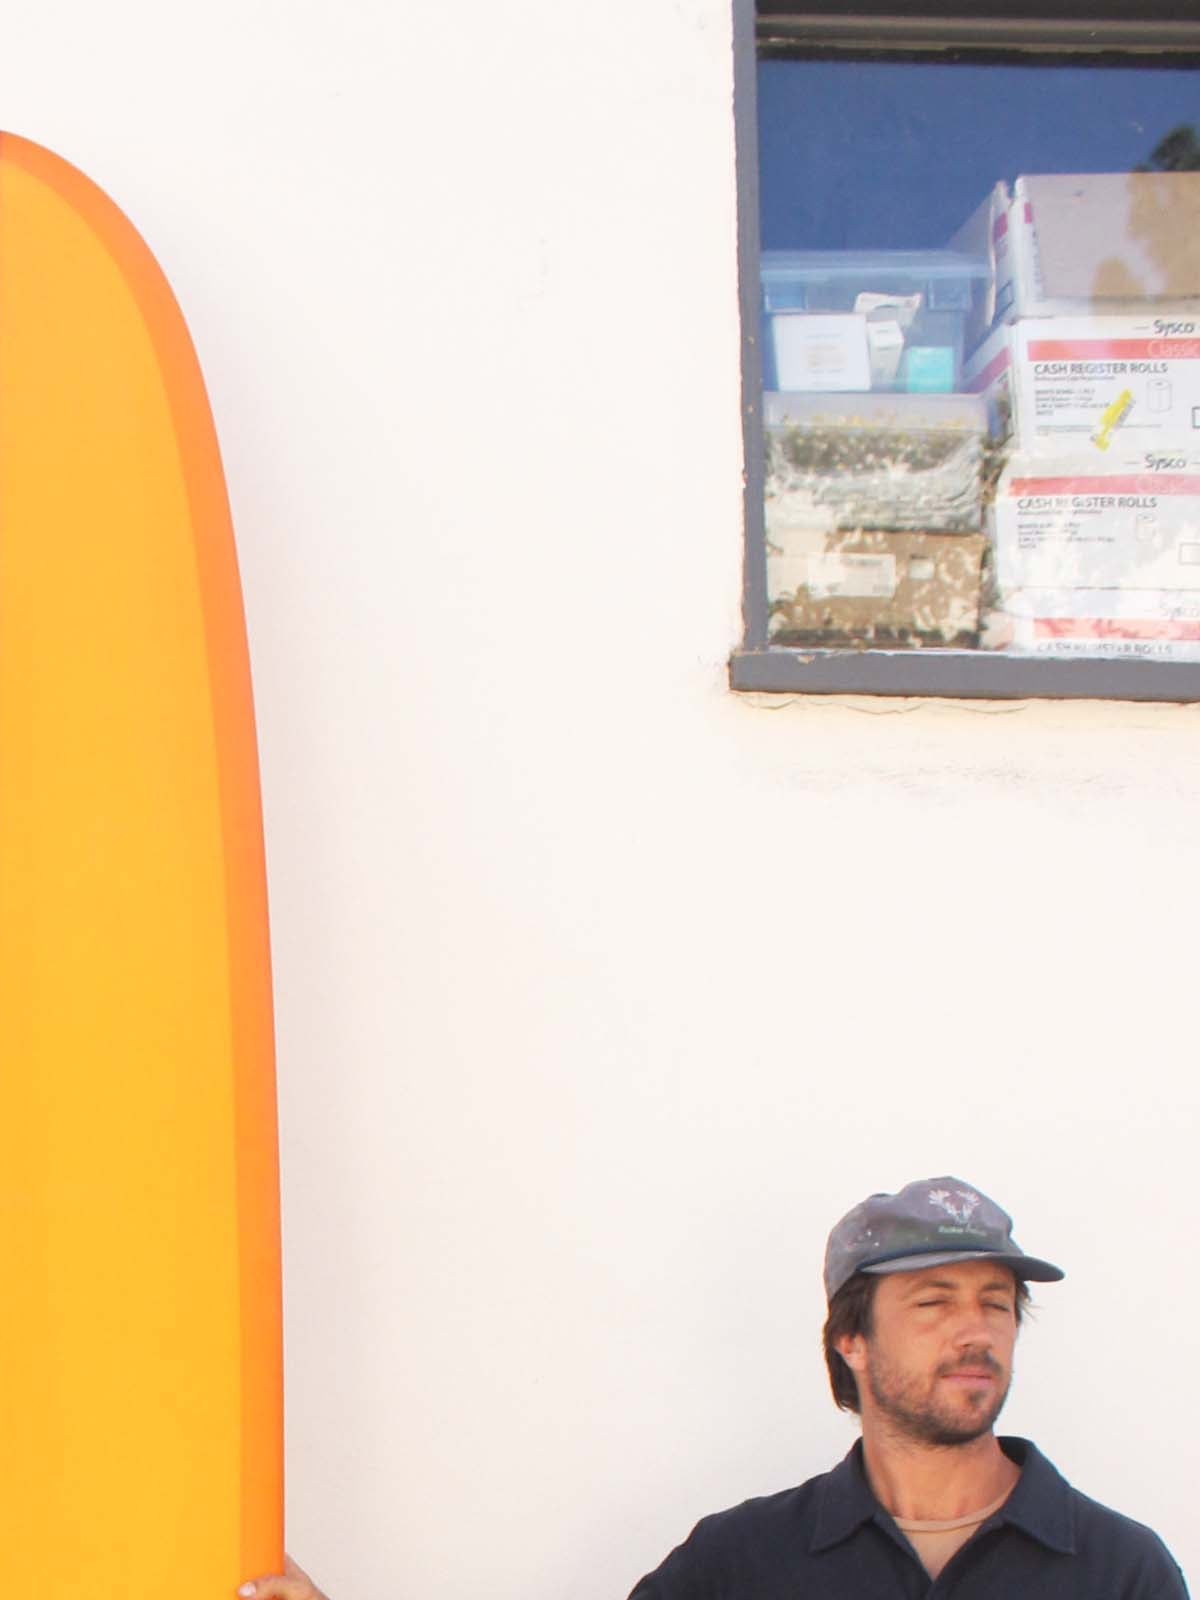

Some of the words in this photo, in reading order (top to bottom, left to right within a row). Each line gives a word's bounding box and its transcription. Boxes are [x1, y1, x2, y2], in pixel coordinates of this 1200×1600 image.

[1154, 319, 1195, 336] Sysco
[1034, 364, 1068, 375] CASH
[1070, 363, 1127, 375] REGISTER
[1130, 362, 1169, 374] ROLLS
[1144, 454, 1187, 471] Sysco
[1017, 498, 1052, 509] CASH
[1056, 497, 1115, 509] RGISTER
[1118, 496, 1157, 508] ROLLS
